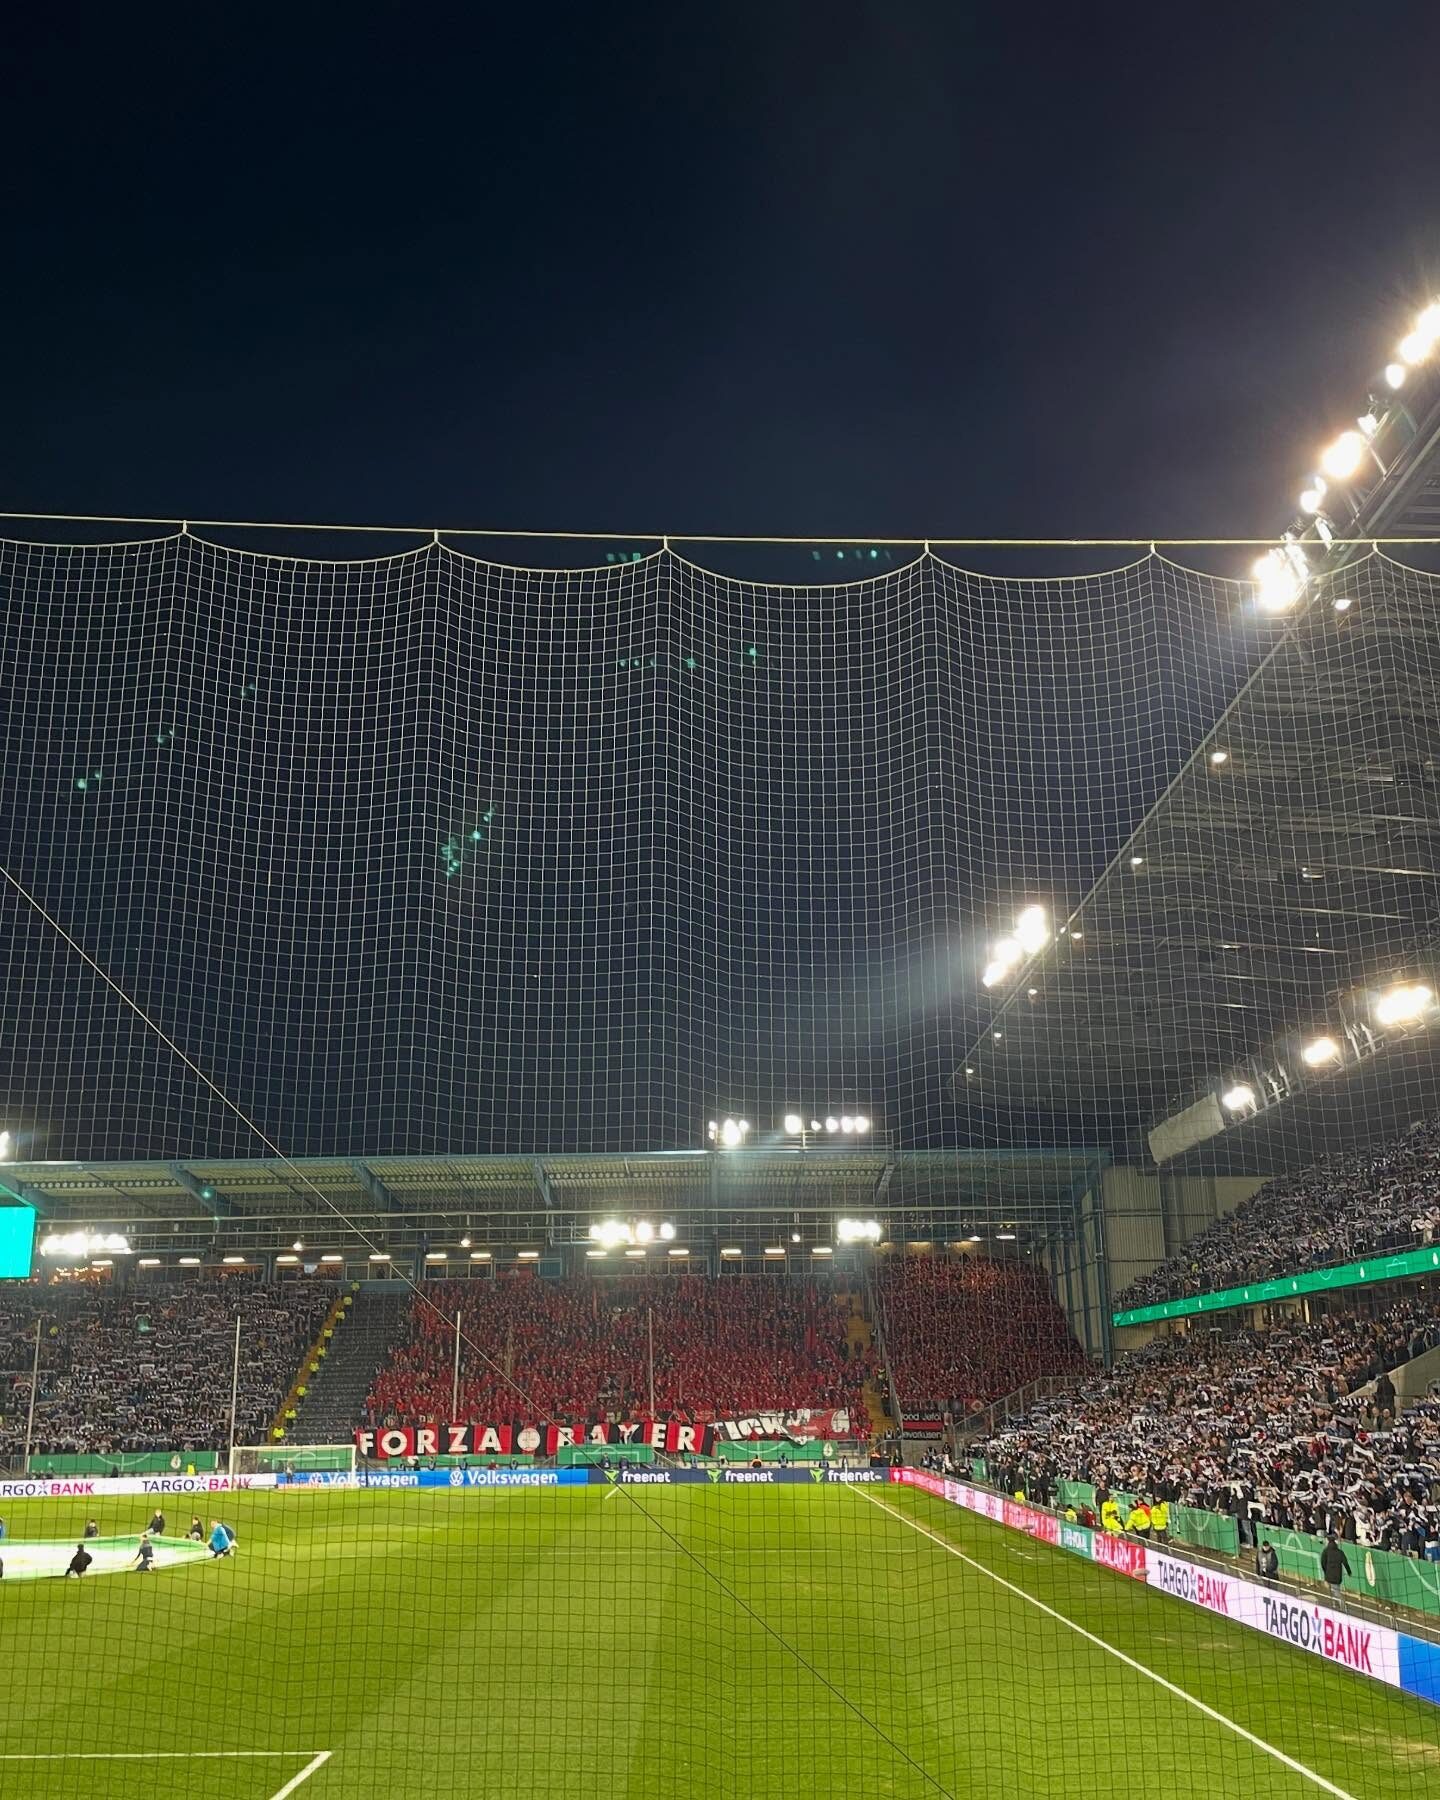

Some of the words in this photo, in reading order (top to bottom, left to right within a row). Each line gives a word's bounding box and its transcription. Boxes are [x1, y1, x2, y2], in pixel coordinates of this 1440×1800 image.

[360, 1427, 502, 1455] FORZA
[557, 1424, 697, 1451] BAYER
[468, 1470, 557, 1486] Volkswagen
[622, 1471, 670, 1483] freenet
[725, 1470, 773, 1482] freenet
[828, 1470, 875, 1481] freenet
